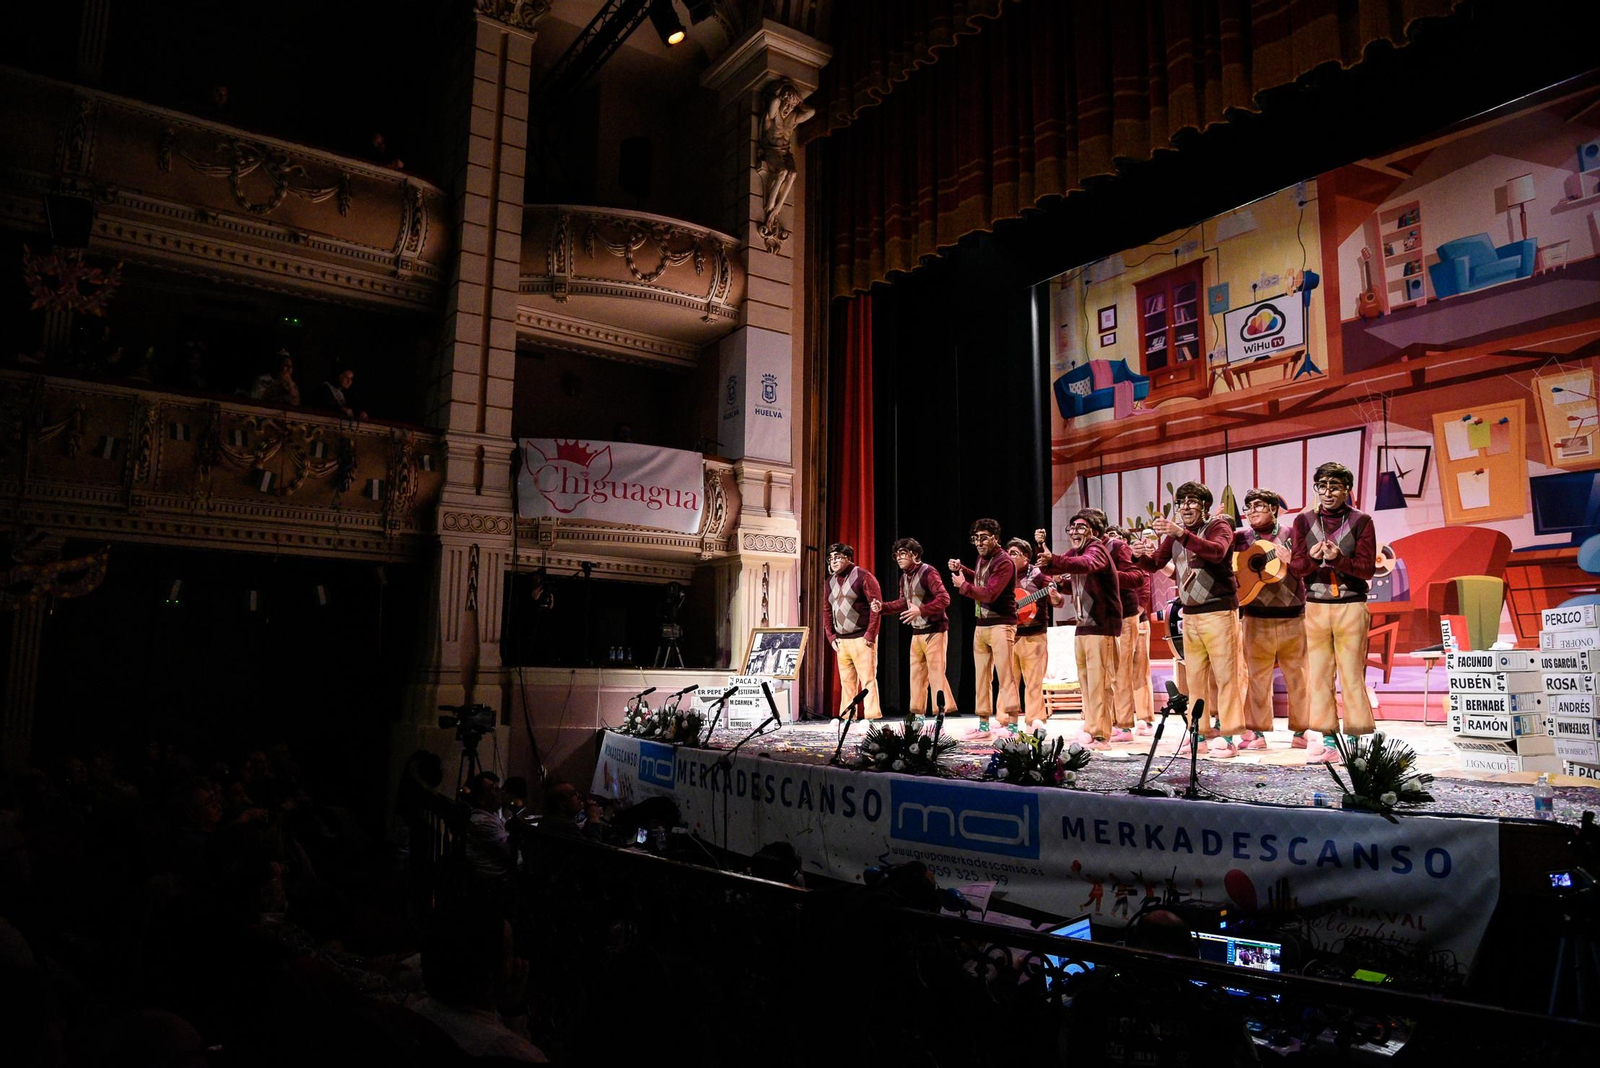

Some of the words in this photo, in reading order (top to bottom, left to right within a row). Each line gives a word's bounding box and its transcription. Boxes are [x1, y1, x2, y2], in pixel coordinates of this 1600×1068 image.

[1244, 341, 1270, 354] WiHu
[755, 408, 783, 419] HUELVA
[534, 464, 699, 511] Chiguagua
[1545, 611, 1582, 626] PERICO
[1442, 623, 1452, 648] PURI
[1457, 656, 1493, 668] FACUNDO
[1541, 658, 1553, 669] LOS
[1554, 656, 1578, 669] GARCÍA
[1450, 674, 1491, 689] RUBÉN
[1546, 678, 1578, 690] ROSA
[1465, 697, 1505, 712] BERNABÉ
[1558, 699, 1591, 713] ANDRÉS
[1468, 718, 1508, 732] RAMÓN
[1579, 767, 1600, 780] PAC
[677, 758, 882, 822] MERKADESCANSO
[1062, 815, 1452, 879] MERKADESCANSO
[891, 847, 1045, 877] www.grupomerkadescanso.es
[928, 864, 951, 878] 959
[956, 868, 980, 882] 325
[1316, 903, 1427, 932] RNAVAL
